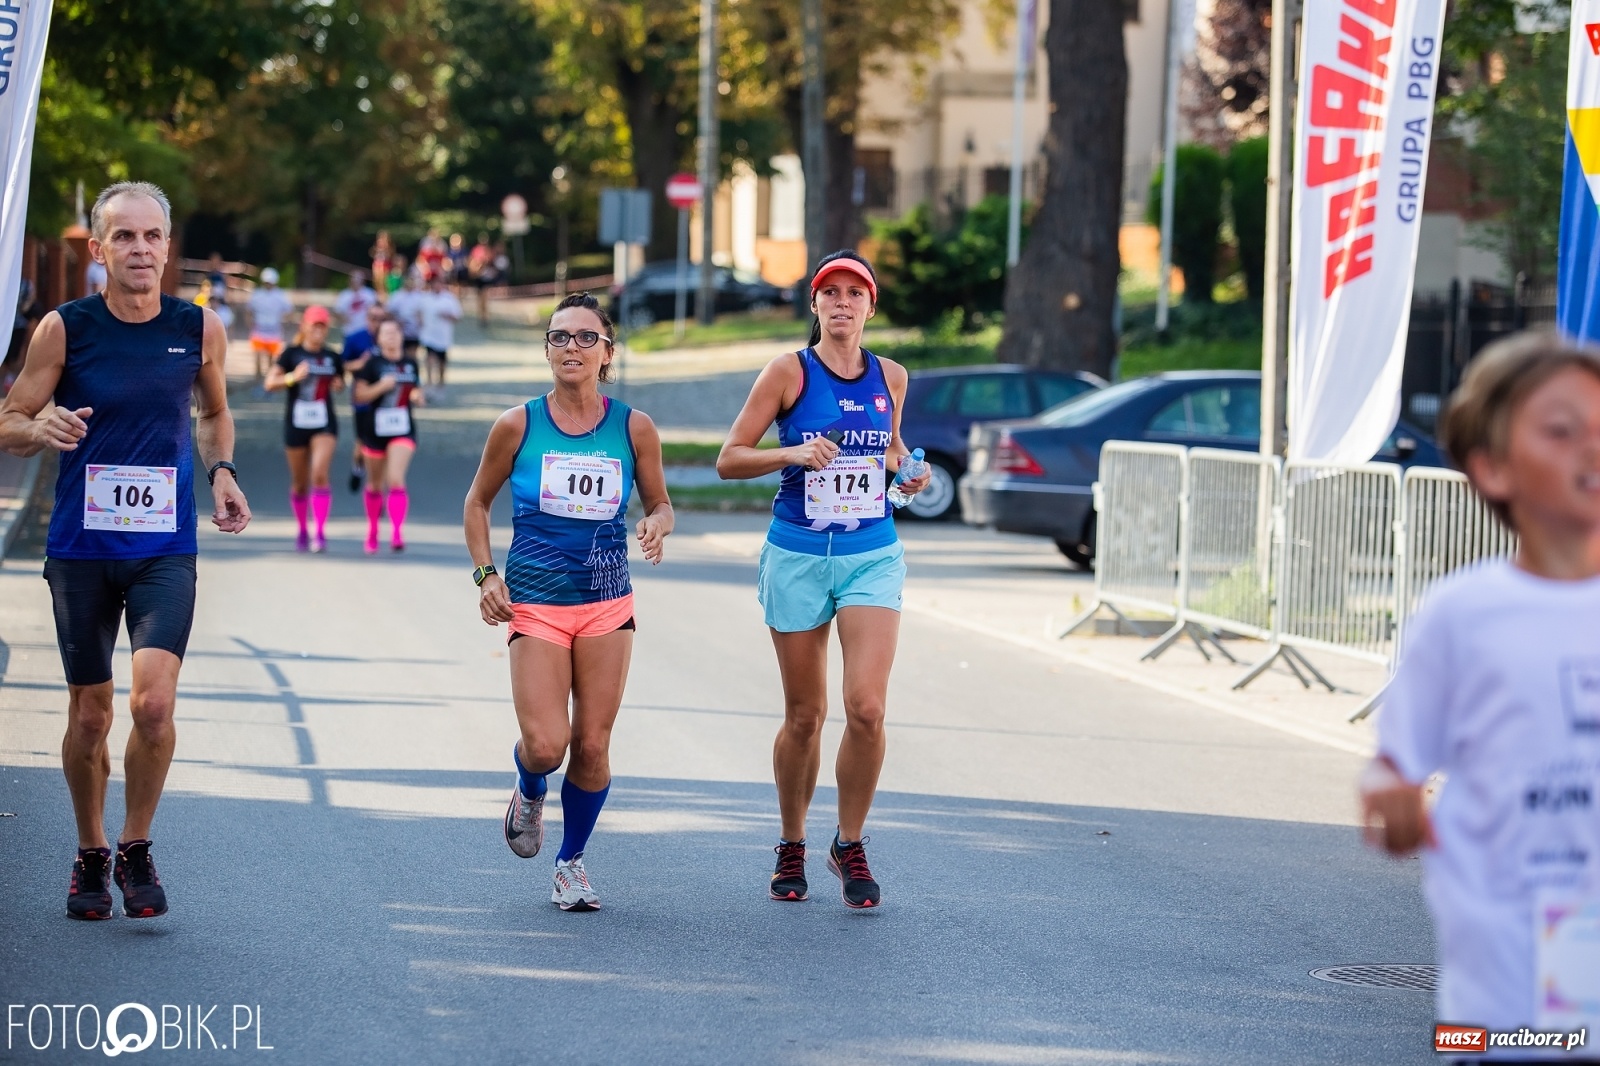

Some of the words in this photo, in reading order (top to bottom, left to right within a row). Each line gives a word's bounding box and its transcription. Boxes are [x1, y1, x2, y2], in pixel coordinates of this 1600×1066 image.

[1407, 36, 1434, 100] PBG
[1398, 116, 1427, 224] GRUPA
[112, 484, 154, 507] 106
[567, 473, 604, 497] 101
[833, 473, 870, 494] 174
